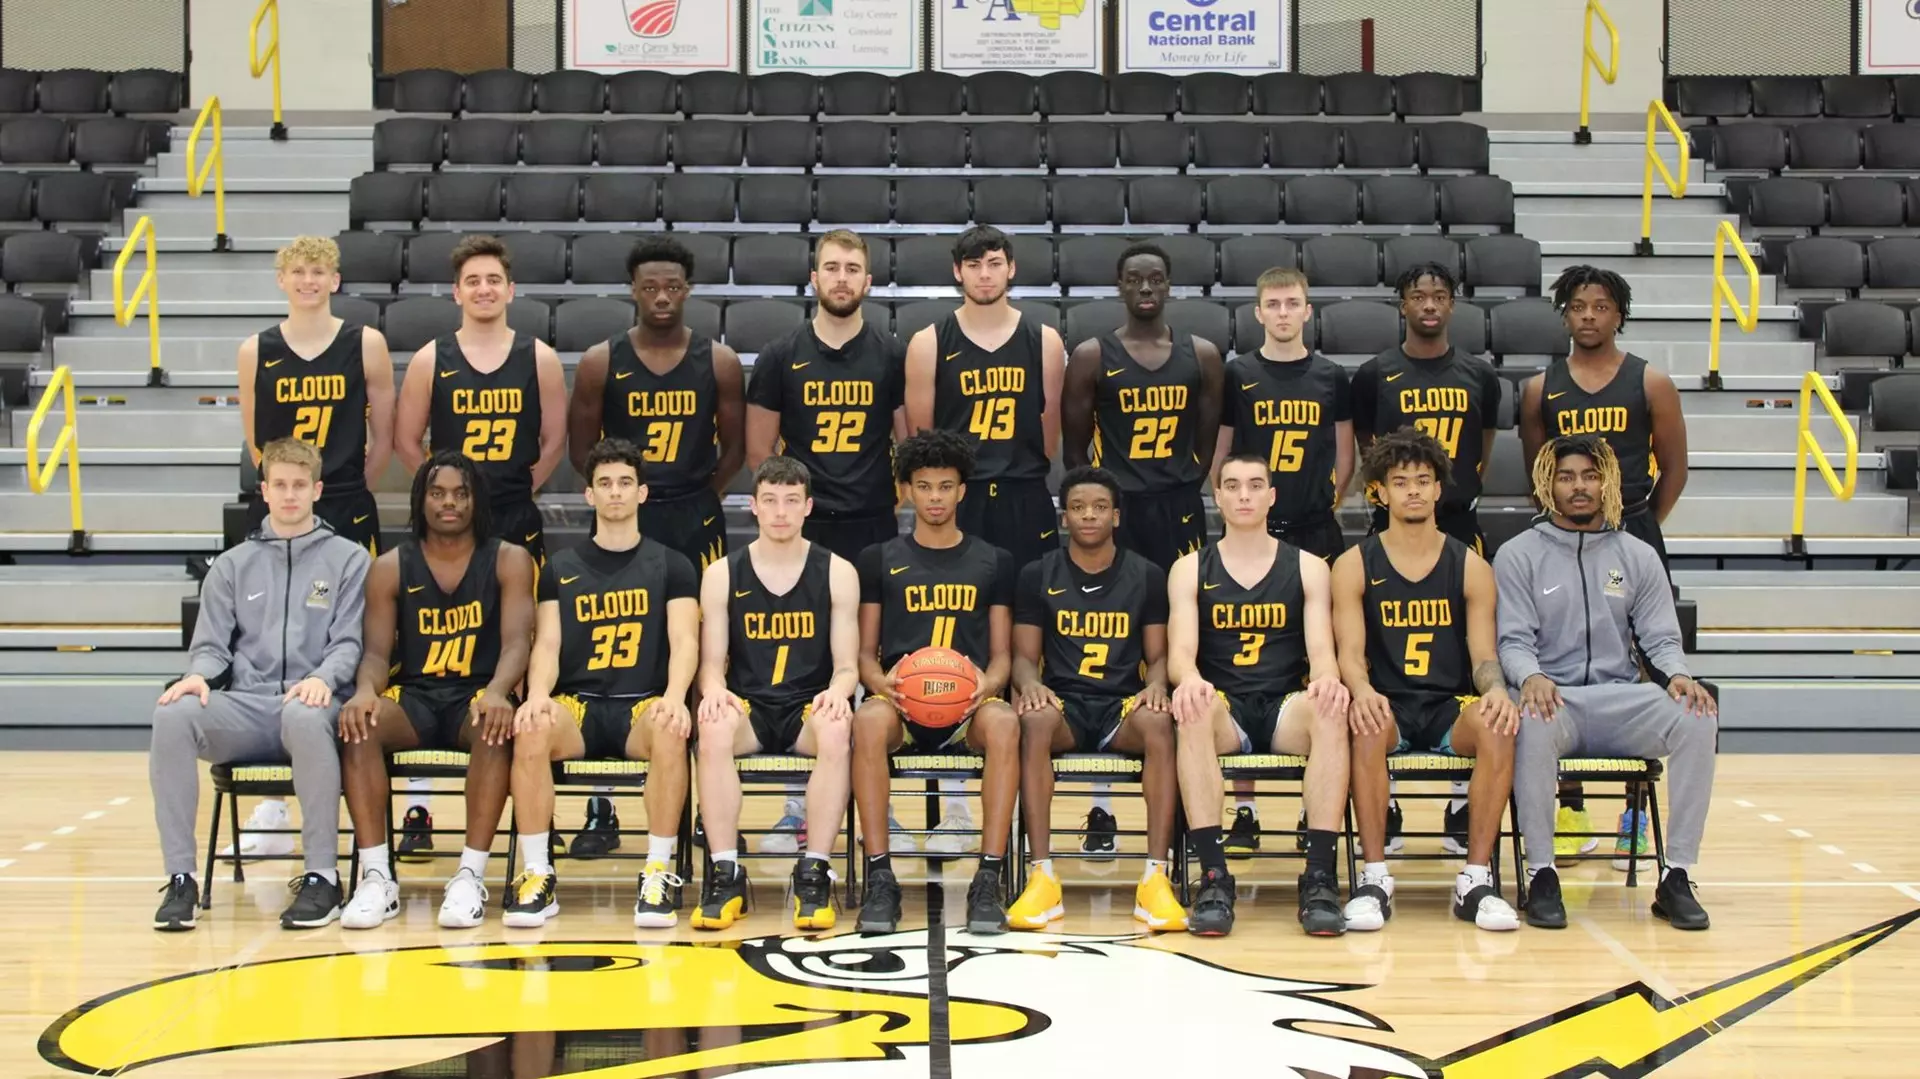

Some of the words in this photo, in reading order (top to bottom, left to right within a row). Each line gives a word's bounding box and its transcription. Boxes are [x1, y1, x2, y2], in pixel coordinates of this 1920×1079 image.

[763, 16, 835, 32] CITIZENS
[1148, 10, 1256, 31] Central
[763, 33, 837, 49] NATIONAL
[1148, 34, 1213, 46] National
[1218, 34, 1256, 46] Bank
[763, 50, 808, 66] BANK
[1159, 51, 1201, 64] Money
[1202, 51, 1221, 64] for
[1223, 51, 1248, 65] Life
[276, 375, 345, 402] CLOUD
[804, 381, 873, 405] CLOUD
[960, 367, 1025, 395] CLOUD
[453, 388, 522, 414] CLOUD
[628, 391, 696, 416] CLOUD
[1120, 386, 1187, 412] CLOUD
[1254, 400, 1320, 425] CLOUD
[1400, 388, 1468, 413] CLOUD
[293, 406, 333, 448] 21
[811, 412, 866, 452] 32
[969, 398, 1015, 440] 43
[1558, 407, 1627, 435] CLOUD
[462, 419, 516, 461] 23
[642, 422, 683, 462] 31
[1130, 416, 1178, 459] 22
[1269, 430, 1309, 472] 15
[989, 483, 997, 497] C
[575, 589, 648, 623] CLOUD
[905, 584, 977, 612] CLOUD
[419, 601, 482, 635] CLOUD
[744, 612, 814, 639] CLOUD
[1057, 610, 1129, 638] CLOUD
[1213, 603, 1286, 628] CLOUD
[1380, 599, 1452, 627] CLOUD
[587, 622, 642, 670] 33
[930, 616, 956, 648] 11
[422, 634, 476, 677] 44
[1079, 643, 1109, 679] 2
[1233, 633, 1265, 665] 3
[1405, 633, 1433, 676] 5
[772, 645, 789, 684] 1
[231, 766, 293, 781] THUNDERB
[892, 755, 984, 769] THUNDERBIRDS
[1051, 758, 1142, 773] THUNDERBIRDS
[1559, 758, 1648, 772] THUNDERBIRDS
